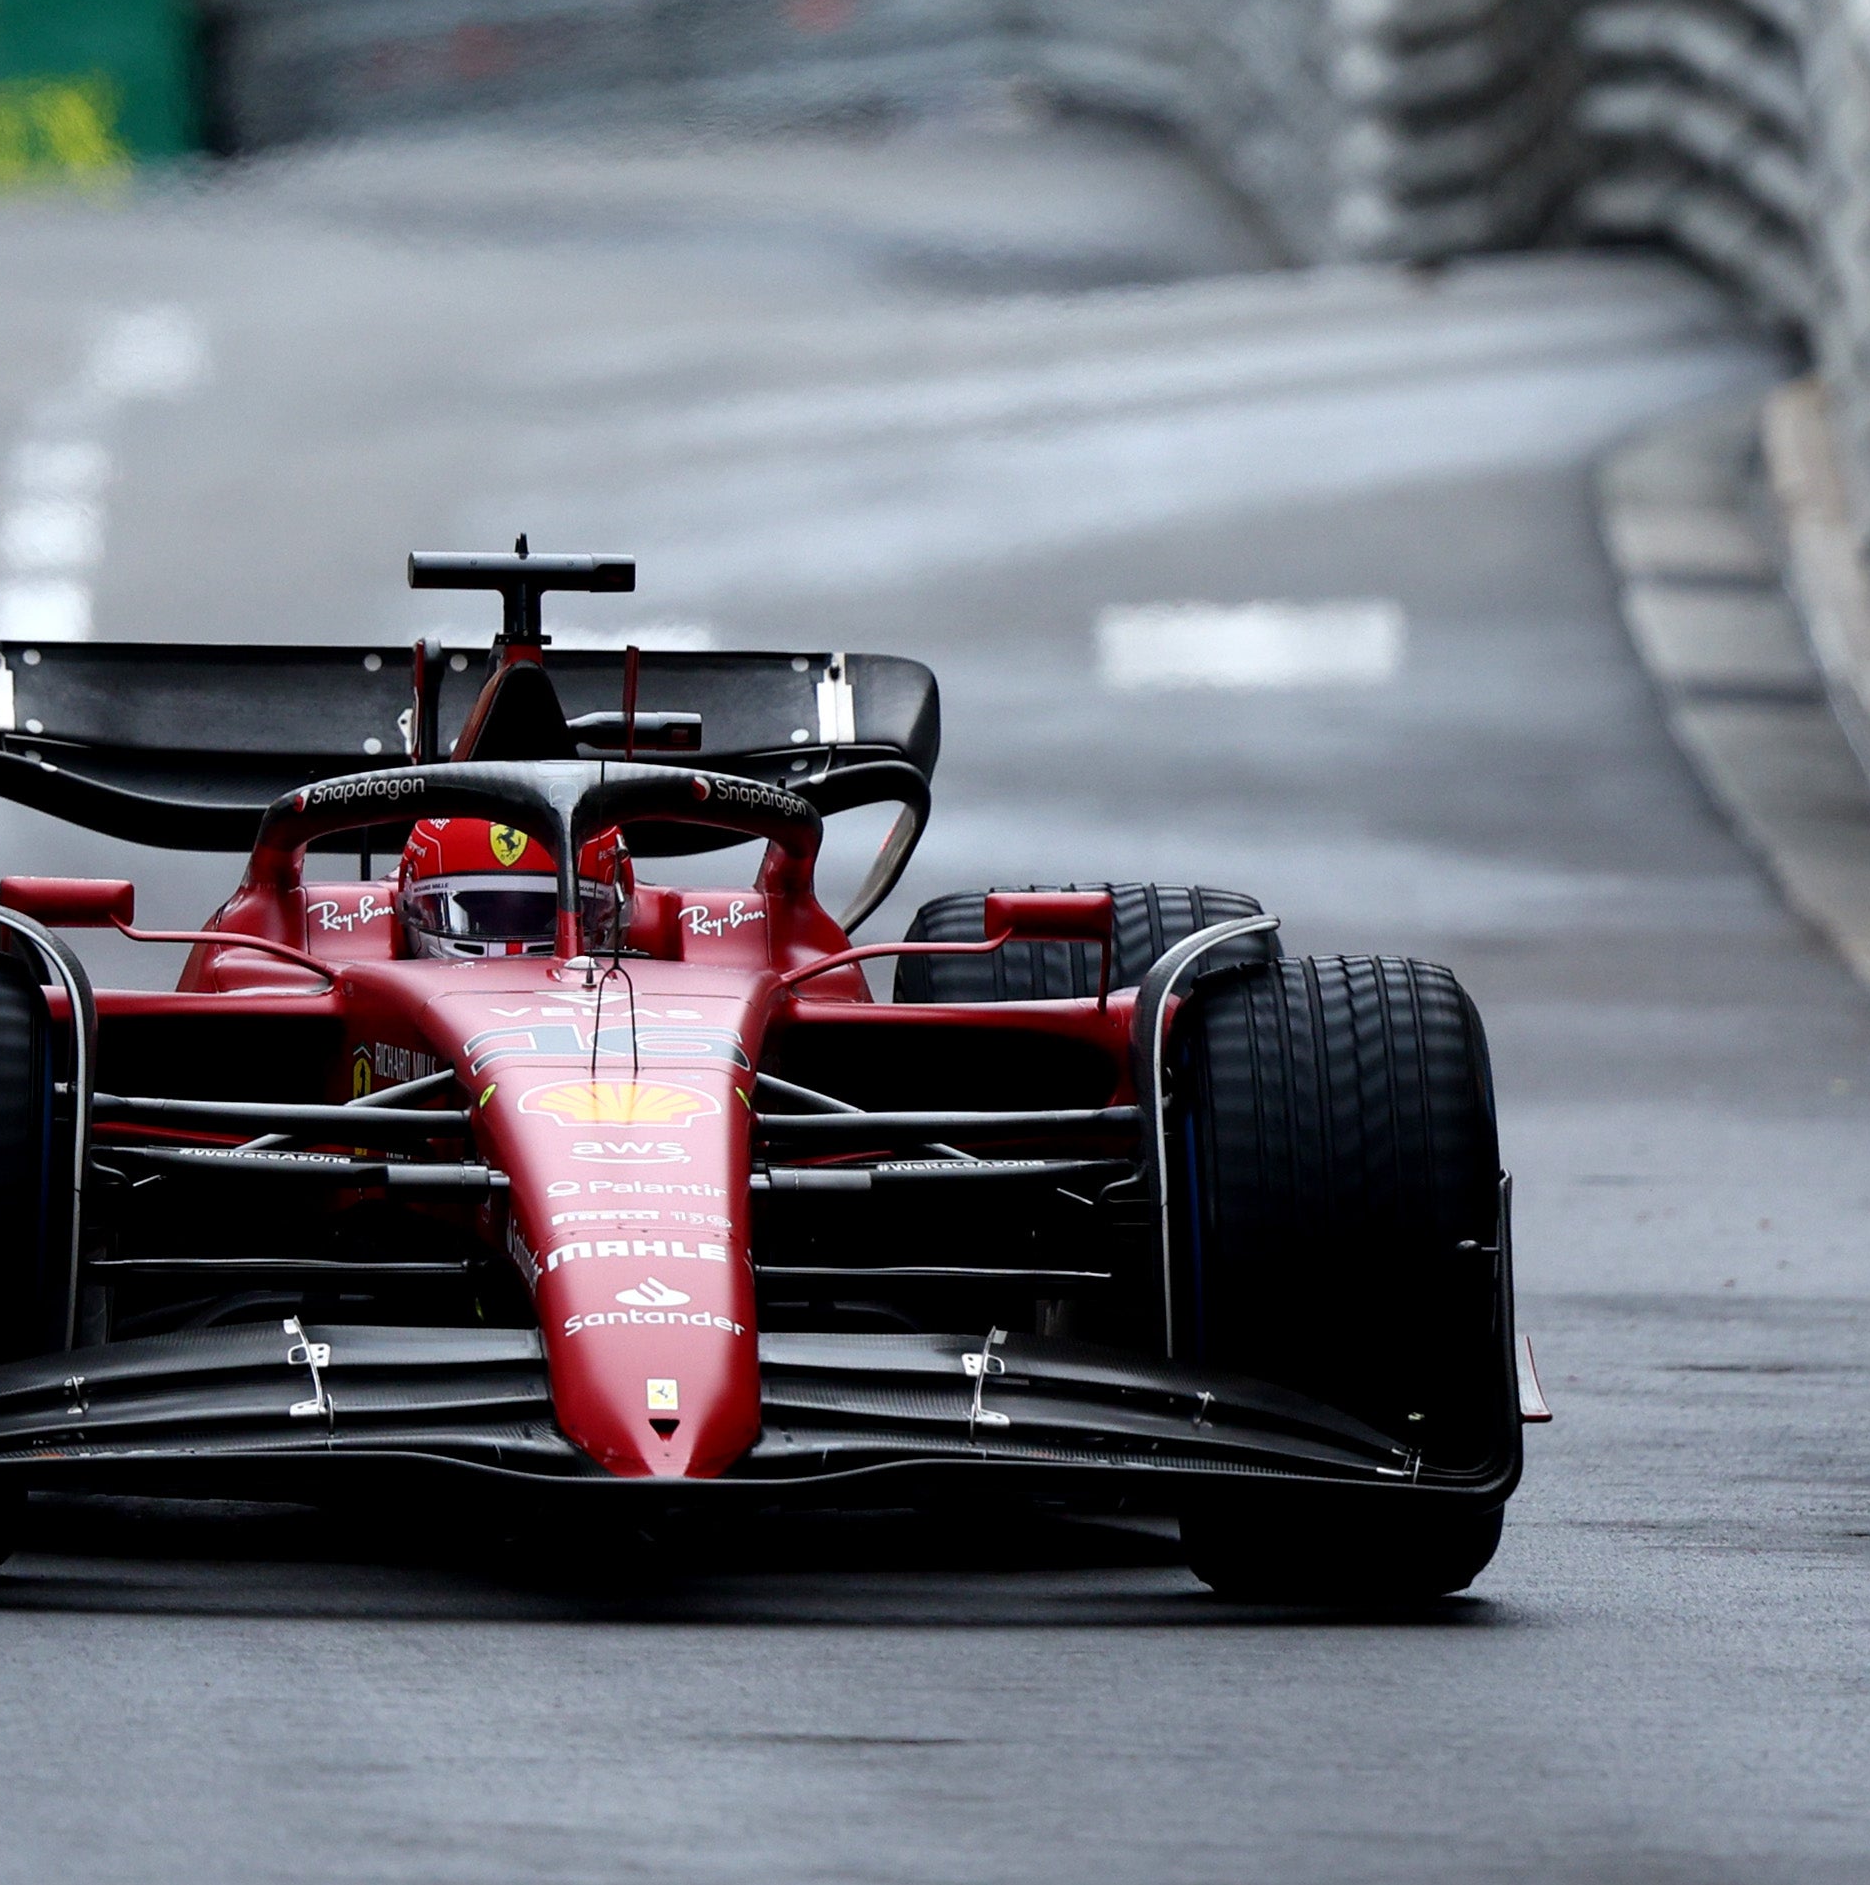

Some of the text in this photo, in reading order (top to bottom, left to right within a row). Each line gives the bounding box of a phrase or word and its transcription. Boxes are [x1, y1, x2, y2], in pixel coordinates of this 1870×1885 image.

[312, 777, 425, 804] Snapdragon
[717, 780, 807, 816] Snapdragon
[307, 896, 395, 931] Ray-Ban
[679, 901, 766, 936] Ray-Ban
[489, 1007, 703, 1020] VELAS
[375, 1042, 410, 1082] RICHARD
[463, 1023, 751, 1076] 16
[179, 1148, 351, 1164] #WeRaceAsOne
[572, 1141, 685, 1155] aws
[588, 1181, 727, 1197] Palantir
[552, 1210, 660, 1225] PIRELLI
[546, 1240, 727, 1271] MAHLE
[564, 1309, 745, 1336] Santander
